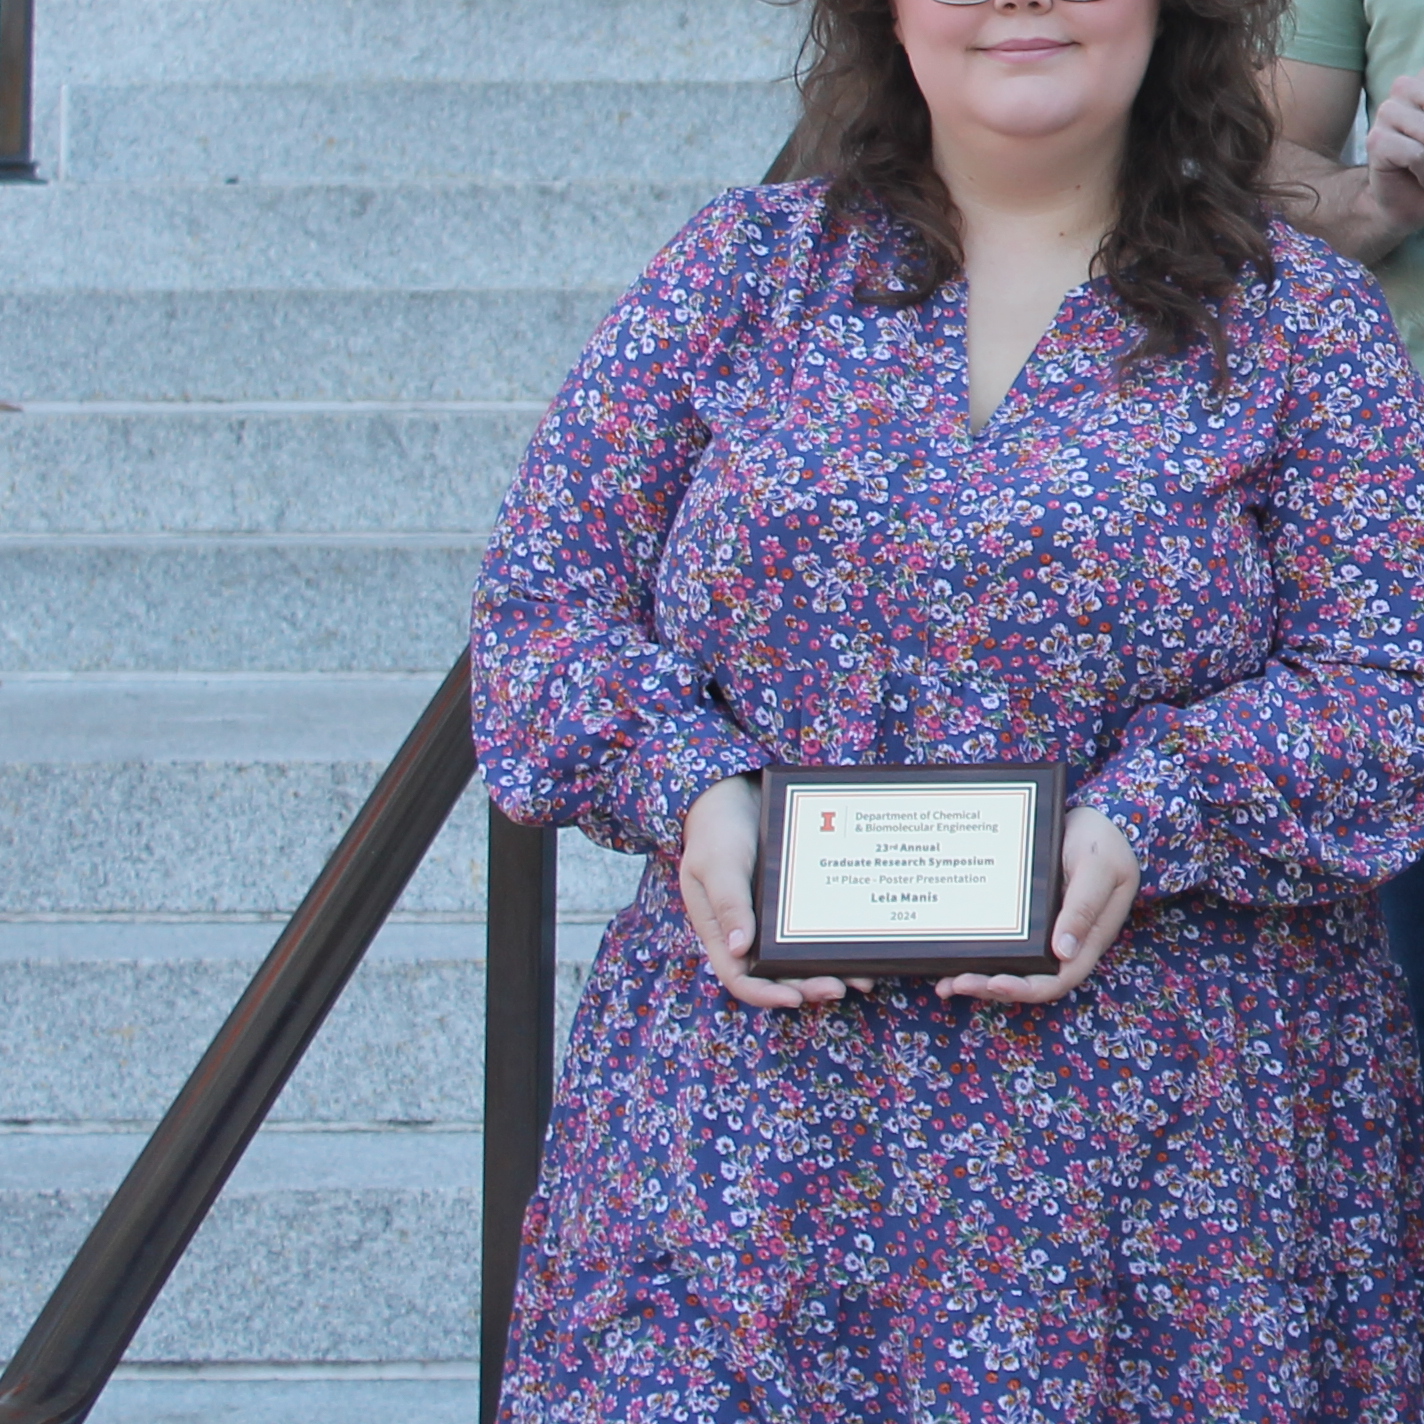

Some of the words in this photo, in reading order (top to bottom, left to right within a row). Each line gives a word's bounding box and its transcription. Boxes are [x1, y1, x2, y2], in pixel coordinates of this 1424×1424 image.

[855, 811, 918, 823] Department
[920, 810, 930, 820] of
[932, 810, 980, 820] Chemical
[855, 824, 862, 832] &
[865, 823, 934, 832] Biomolecular
[937, 822, 998, 834] Engineering
[900, 843, 940, 852] Annual
[819, 857, 872, 867] Graduate
[874, 857, 926, 867] Research
[928, 856, 994, 870] Symposium
[841, 875, 871, 885] Place
[879, 875, 914, 884] Poster
[916, 874, 986, 884] Presentation
[871, 893, 898, 903] Lela
[900, 892, 938, 902] Manis
[890, 911, 916, 921] 2024
